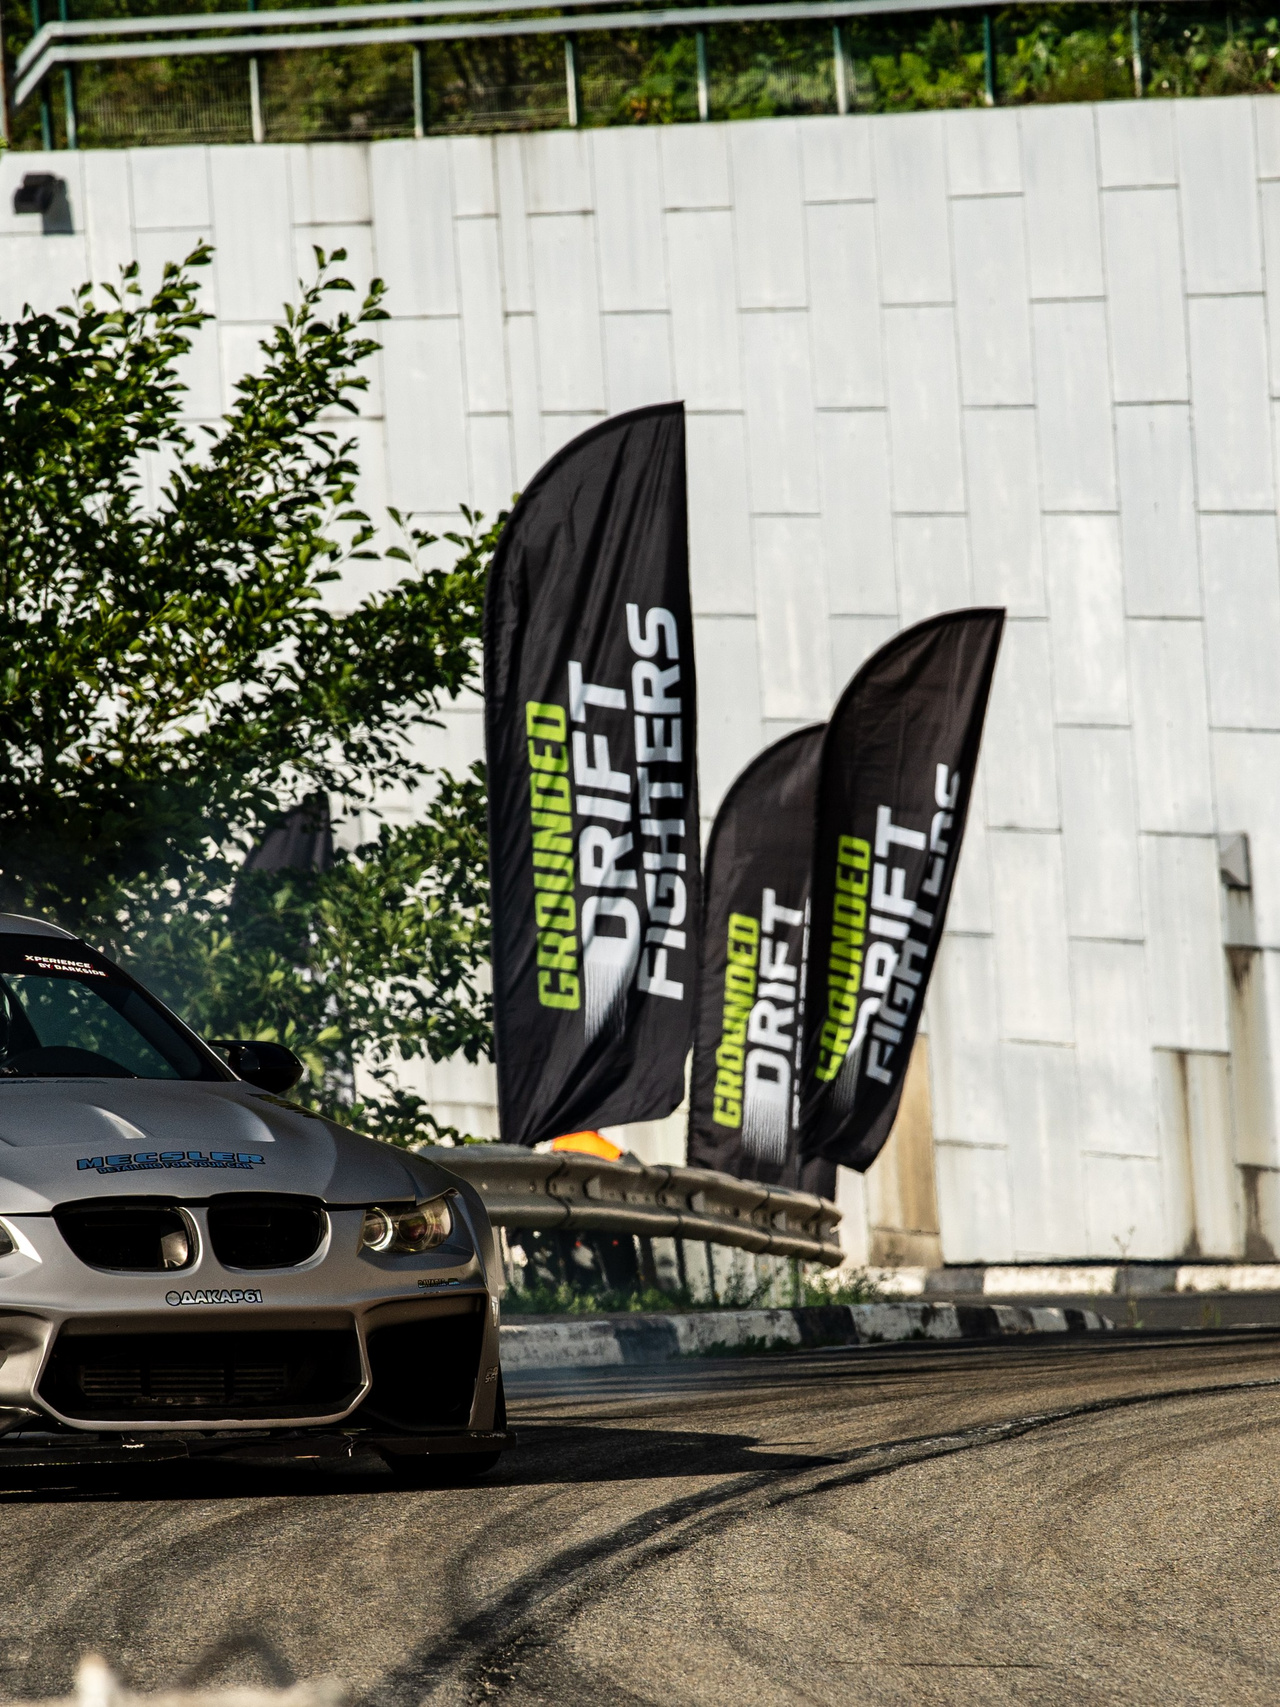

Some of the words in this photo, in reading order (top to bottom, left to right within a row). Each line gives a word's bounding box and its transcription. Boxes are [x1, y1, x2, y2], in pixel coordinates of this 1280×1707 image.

[526, 701, 581, 1011] GROUNDED
[567, 660, 639, 1025] DRIFT
[625, 602, 688, 1002] FIGHTERS
[24, 954, 92, 969] XPERIENCE
[53, 964, 107, 977] DARKSIDE
[712, 912, 760, 1129] GROUNDED
[742, 887, 804, 1135] DRIFT
[76, 1151, 266, 1171] MECSLER
